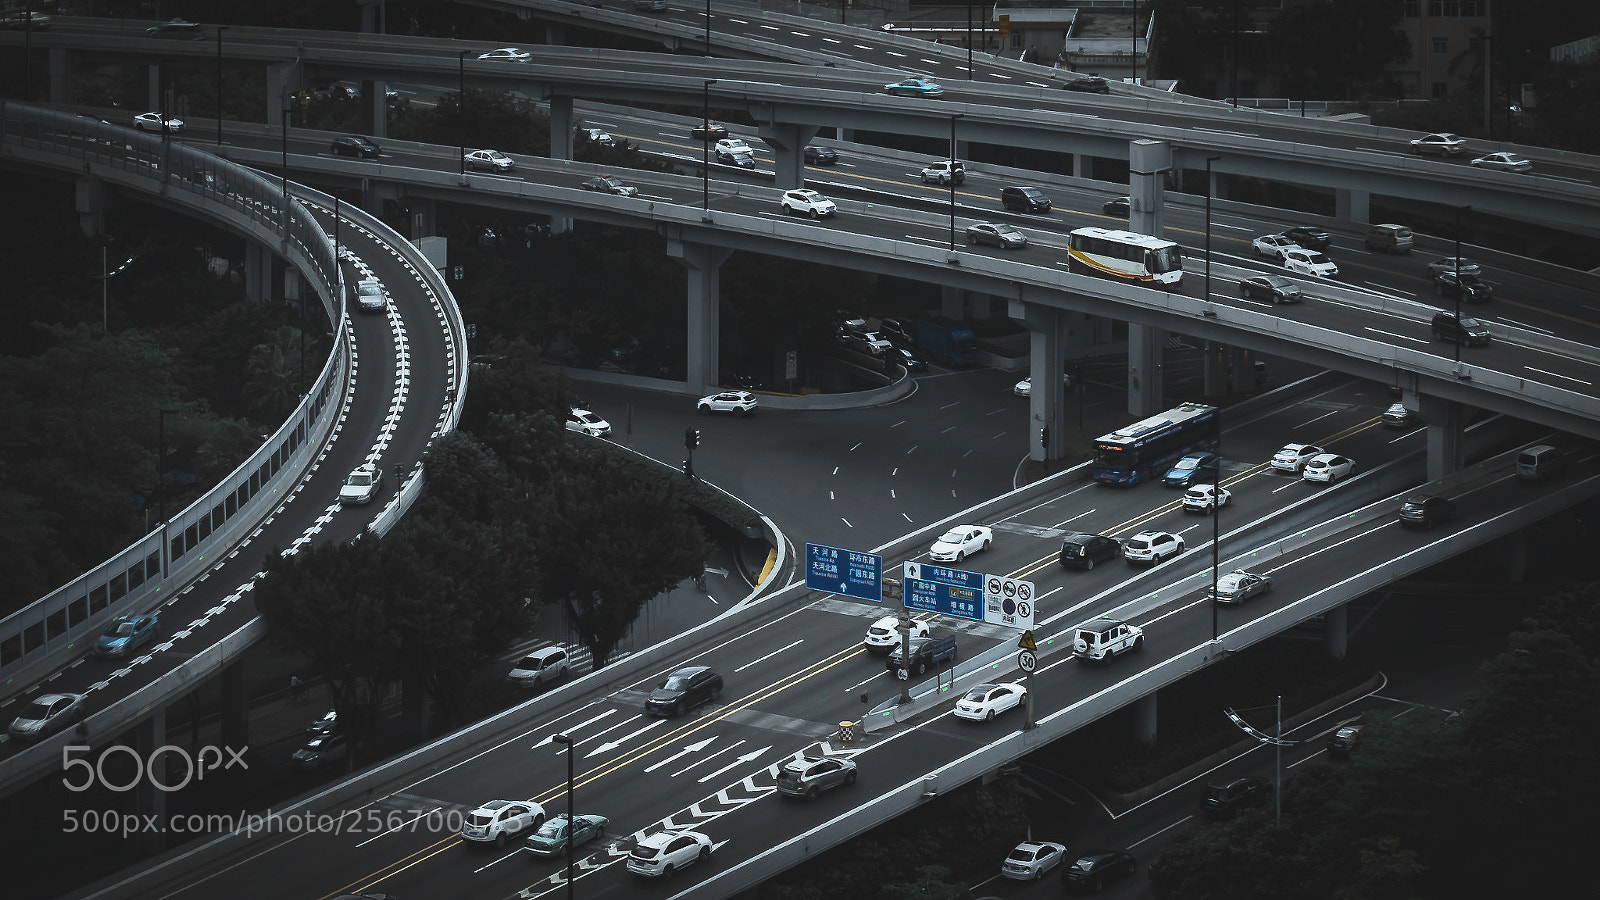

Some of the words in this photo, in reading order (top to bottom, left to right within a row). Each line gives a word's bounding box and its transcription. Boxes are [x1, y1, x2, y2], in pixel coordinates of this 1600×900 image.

[812, 561, 838, 574] 天河北路
[849, 568, 875, 580] 广园东路
[1022, 655, 1034, 669] 30
